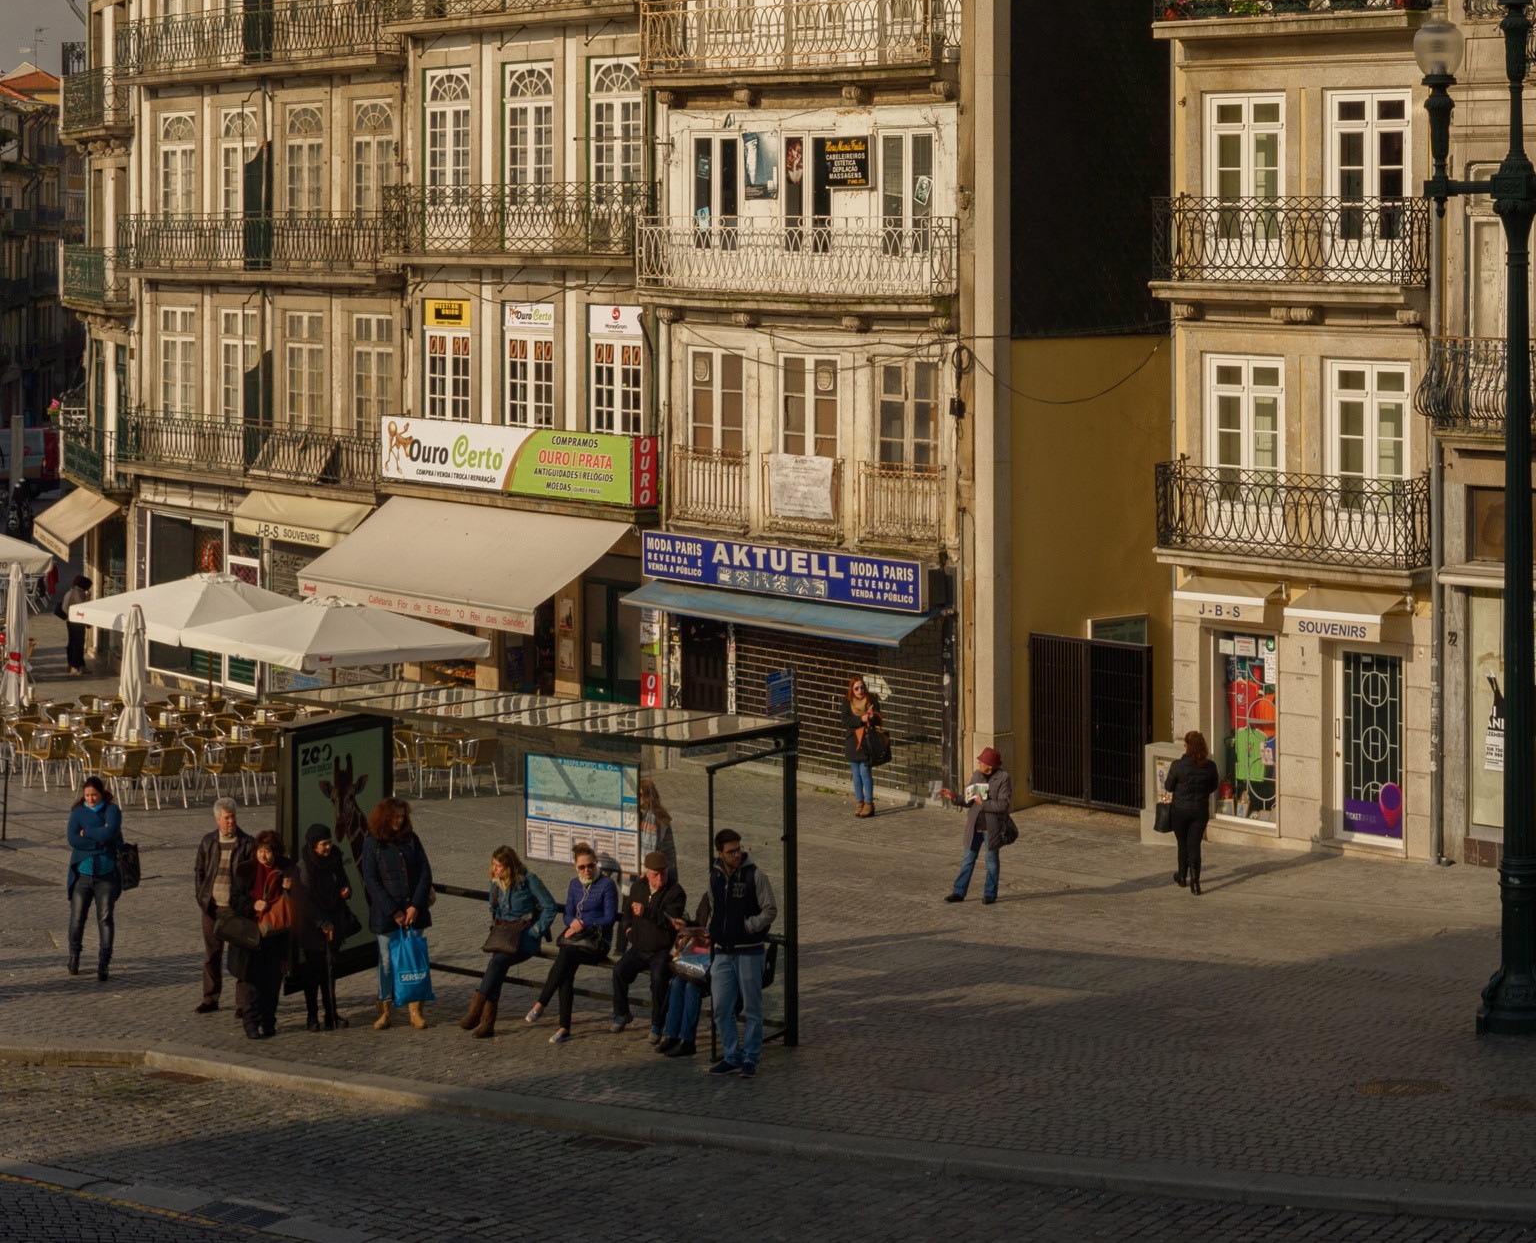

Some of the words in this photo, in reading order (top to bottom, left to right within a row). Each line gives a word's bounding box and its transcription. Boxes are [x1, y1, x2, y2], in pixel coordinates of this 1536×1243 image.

[516, 310, 532, 320] Ouro
[532, 307, 552, 322] Certo
[551, 436, 599, 448] COMPRAMOS
[409, 438, 449, 465] Ouro
[452, 434, 503, 471] Certo
[538, 449, 571, 466] OURO
[578, 453, 613, 470] PRATA
[416, 468, 434, 476] COMPRA
[436, 471, 451, 479] VENDA
[470, 474, 496, 484] REPARAÇÃO
[534, 467, 579, 479] ANTIGUIDADES
[582, 472, 614, 483] RELÓGIOS
[639, 438, 651, 505] OURO
[546, 481, 571, 492] MOEDAS
[255, 523, 279, 539] J-B-S
[283, 528, 320, 544] SOUVENIRS
[646, 537, 673, 553] MODA
[675, 540, 702, 556] PARIS
[647, 552, 688, 565] REVENDA
[697, 558, 703, 567] E
[712, 542, 844, 579] AKTUELL
[647, 562, 668, 572] VENDA
[669, 564, 675, 573] A
[675, 564, 703, 577] PÚBLICO
[849, 561, 879, 578] MODA
[882, 565, 914, 582] PARIS
[850, 578, 897, 591] REVENDA
[908, 585, 914, 594] E
[850, 588, 874, 600] VENDA
[875, 591, 881, 600] A
[883, 591, 914, 604] PÚBLICO
[397, 599, 409, 610] Flor
[414, 602, 422, 611] de
[434, 606, 451, 617] Bento
[470, 611, 481, 621] Rei
[485, 614, 497, 625] das
[1298, 620, 1367, 639] SOUVENIRS
[301, 743, 333, 766] ZOO
